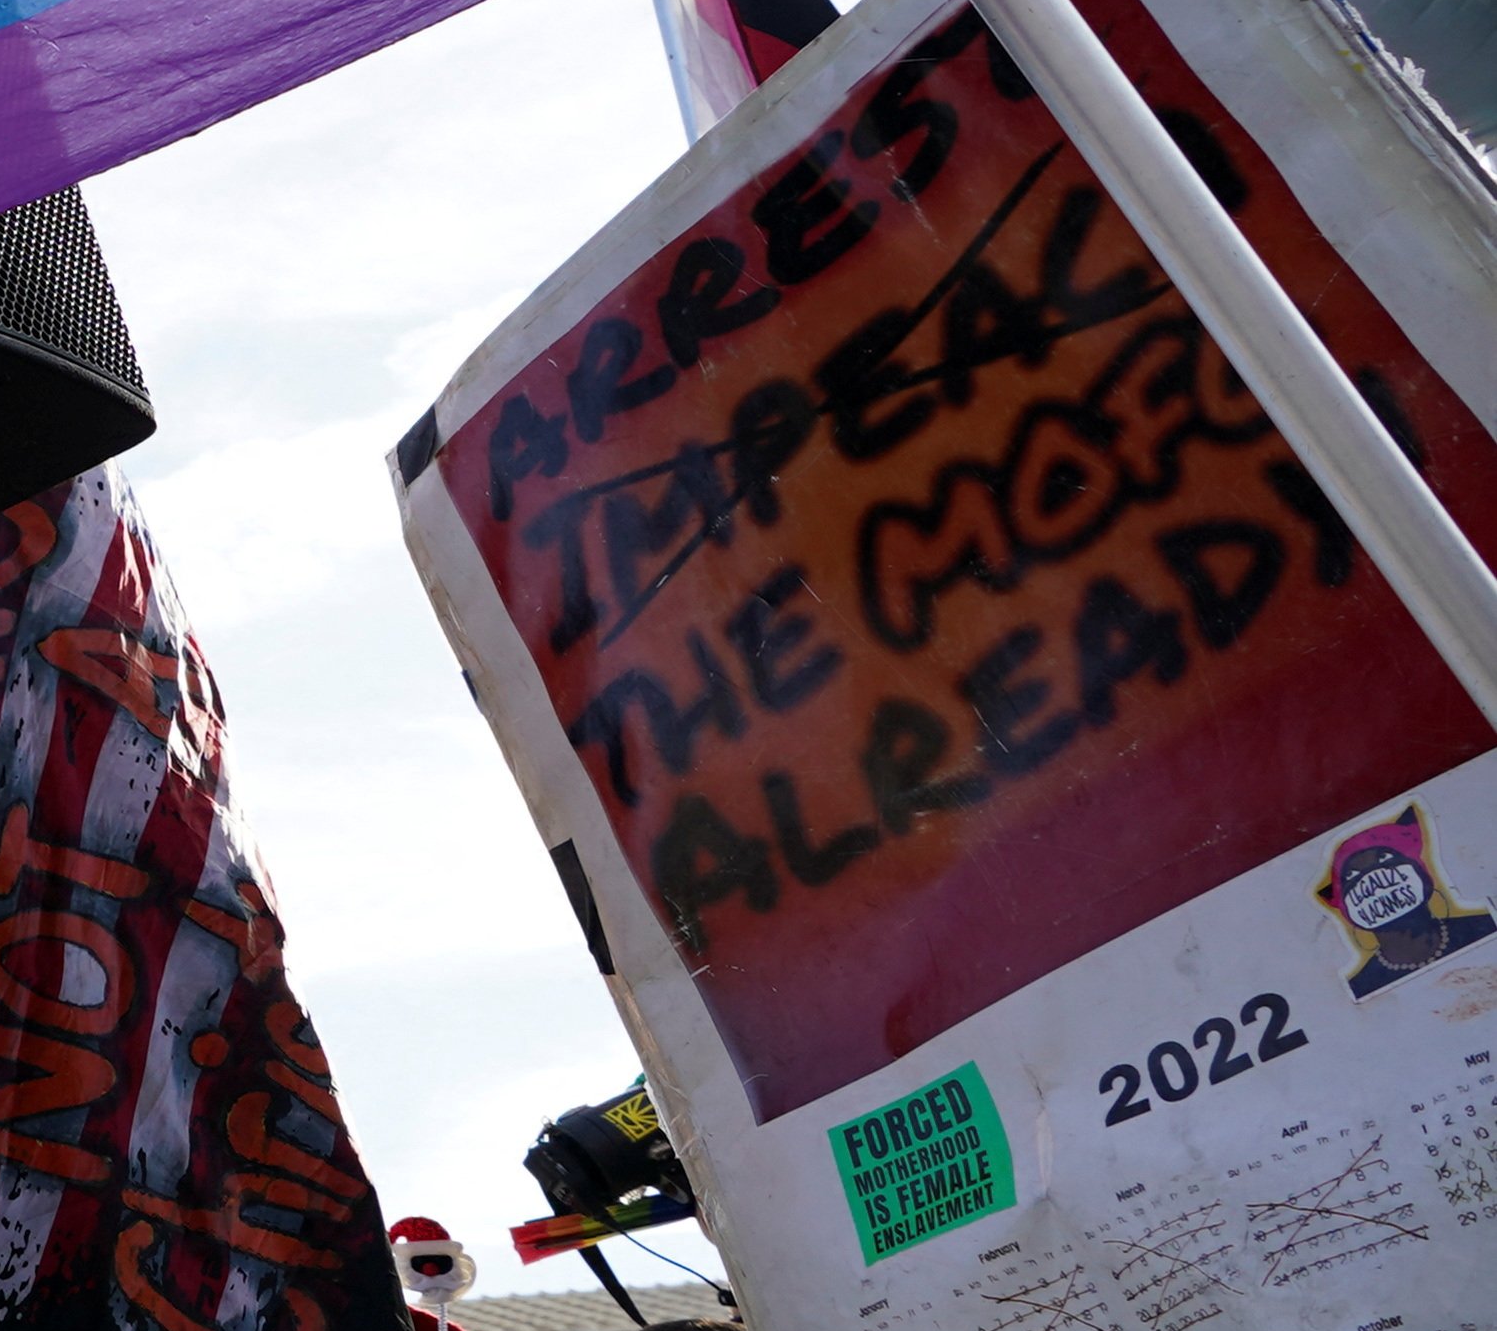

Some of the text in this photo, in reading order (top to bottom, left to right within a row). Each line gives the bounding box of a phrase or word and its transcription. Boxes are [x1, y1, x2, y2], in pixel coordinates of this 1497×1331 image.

[563, 561, 844, 805] THE
[1098, 992, 1310, 1128] 2022
[1464, 1049, 1491, 1069] May
[843, 1079, 974, 1169] FORCED
[853, 1125, 981, 1197] MOTHERHOOD
[1281, 1119, 1309, 1140] April
[864, 1150, 992, 1229] IS FEMALE
[873, 1182, 995, 1254] ENSLAVEMENT
